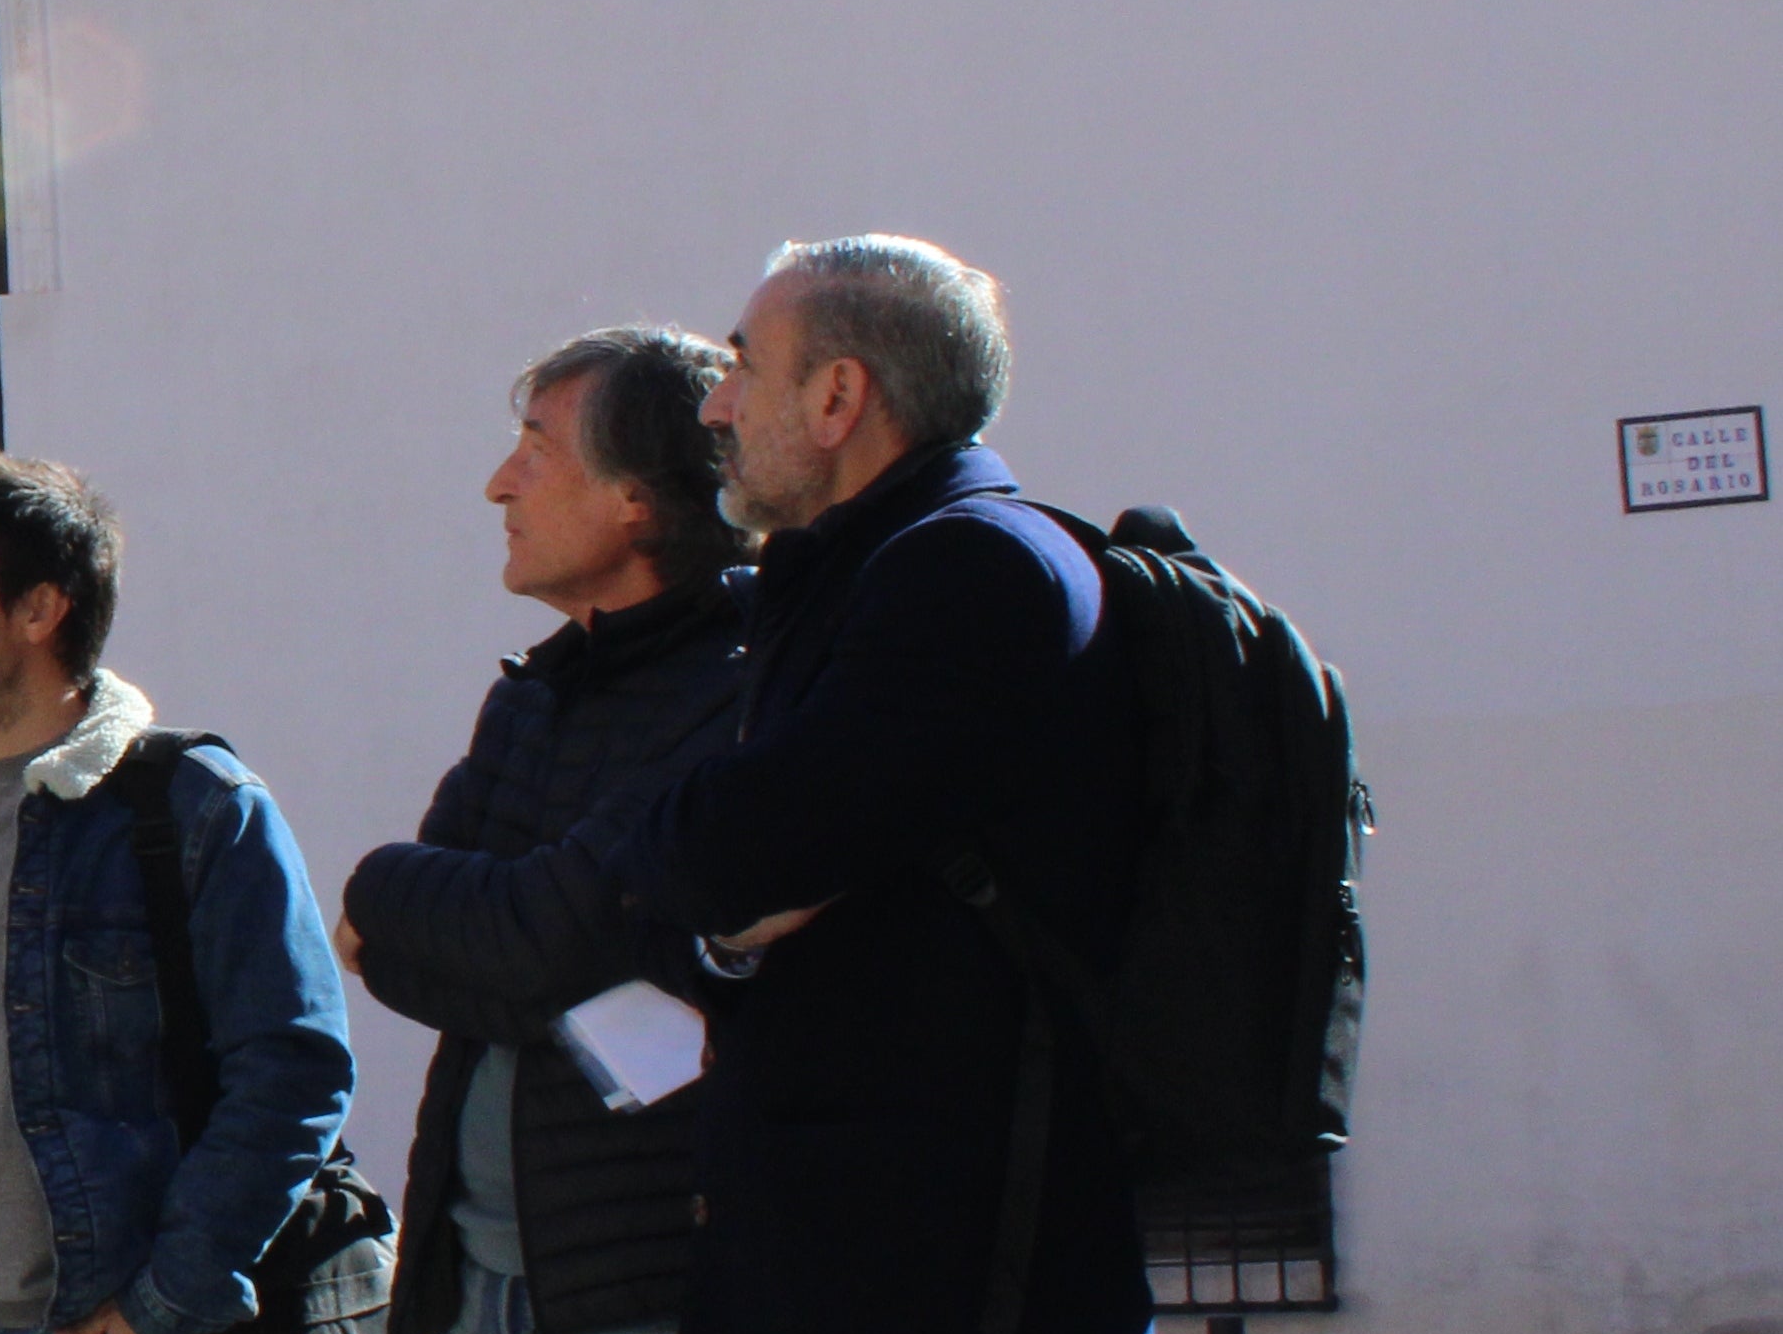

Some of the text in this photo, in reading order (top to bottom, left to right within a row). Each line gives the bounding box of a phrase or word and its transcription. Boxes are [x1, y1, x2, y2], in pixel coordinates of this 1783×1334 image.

[1671, 428, 1747, 447] CALLE
[1687, 453, 1734, 470] DEL
[1641, 473, 1751, 496] ROSARIO
